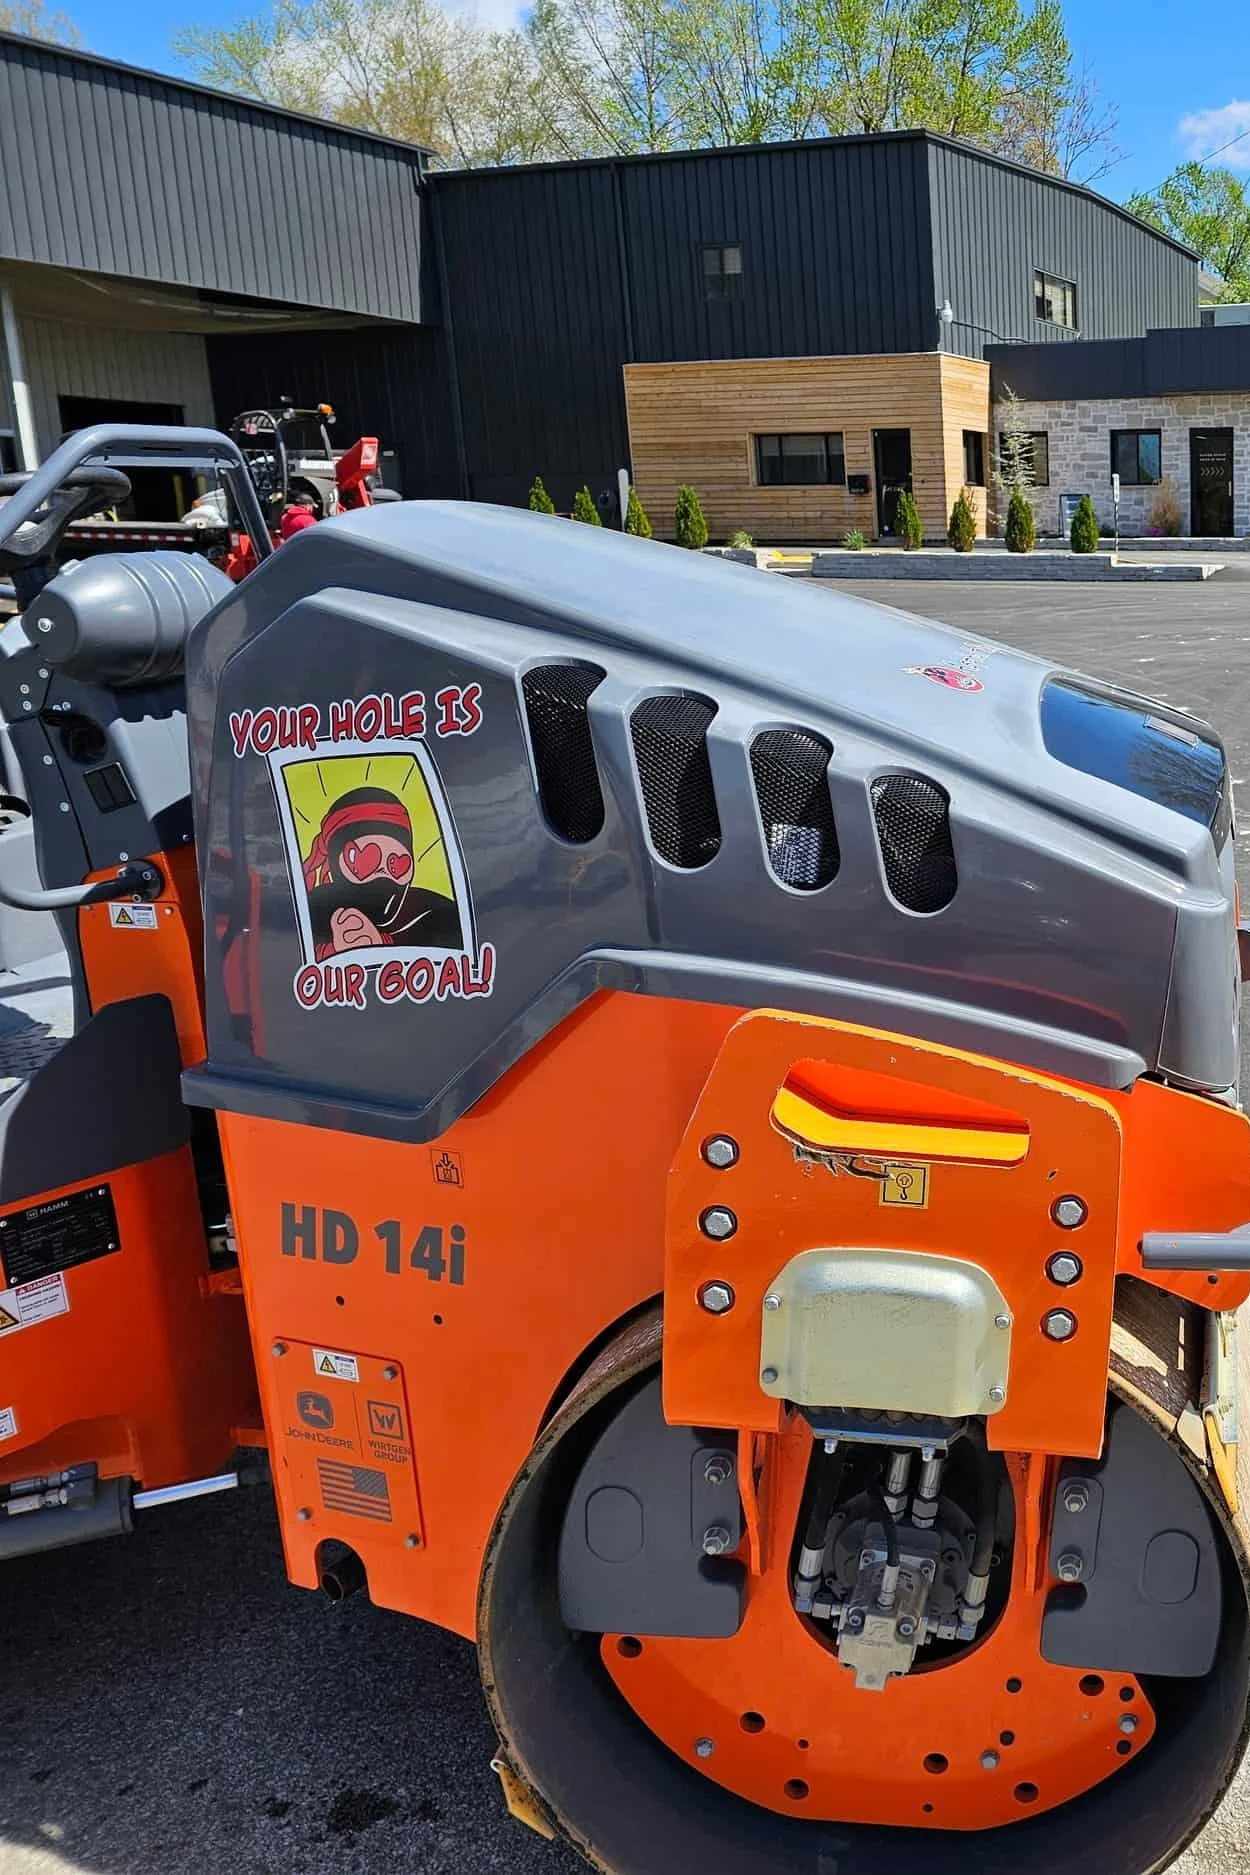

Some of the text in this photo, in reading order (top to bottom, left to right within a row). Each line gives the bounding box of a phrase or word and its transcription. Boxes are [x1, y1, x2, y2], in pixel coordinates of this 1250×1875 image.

[230, 684, 482, 756] YOUR HOLE IS
[295, 944, 494, 1009] OUR GOAL!
[39, 1200, 70, 1214] HAMM
[281, 1202, 466, 1286] HD 14i
[27, 1276, 59, 1291] DANGER
[286, 1427, 354, 1449] JOHN DEERE
[368, 1440, 412, 1456] WIRTGEN
[374, 1451, 409, 1464] GROUP
